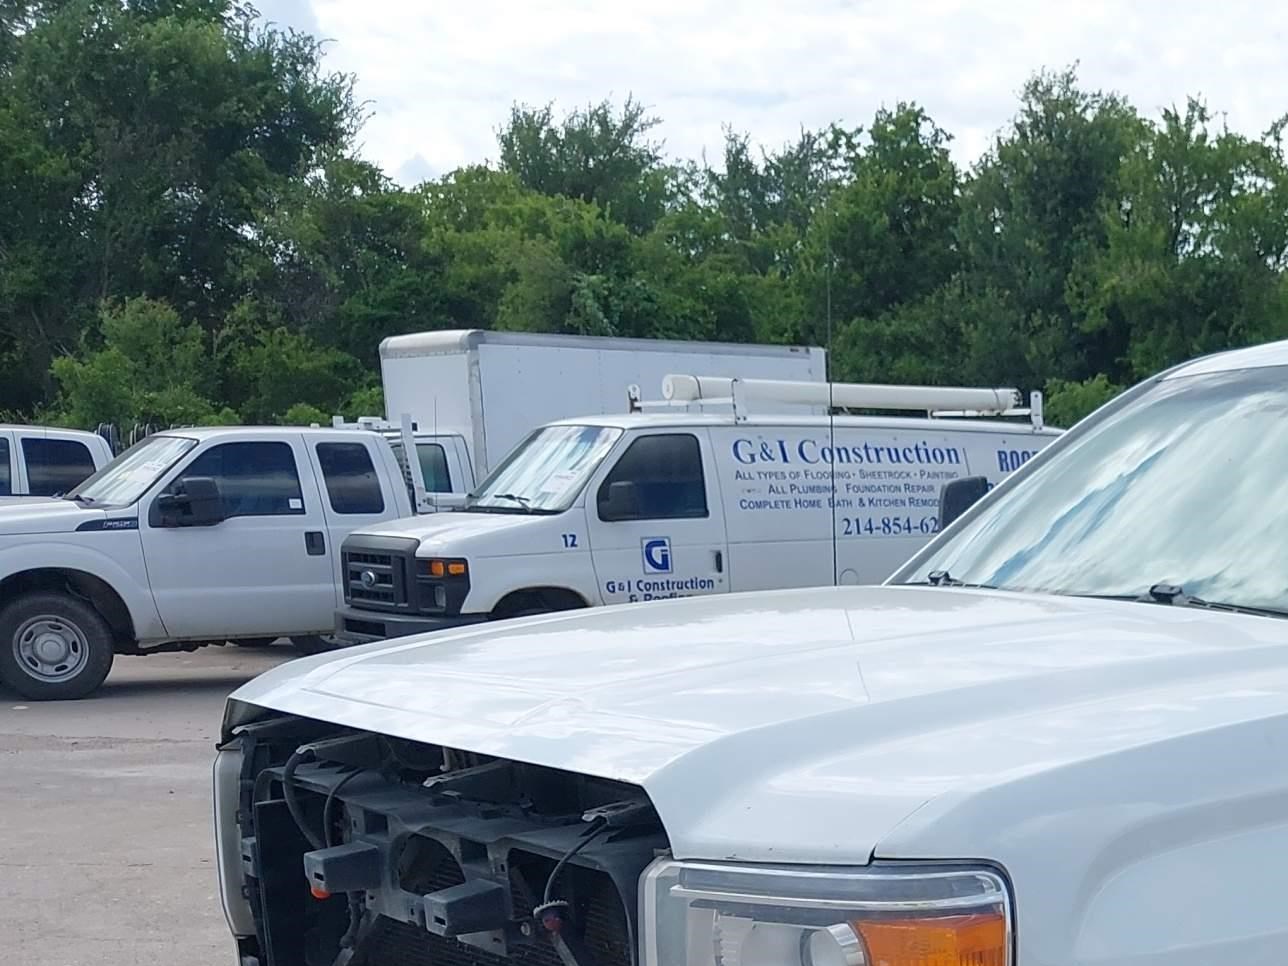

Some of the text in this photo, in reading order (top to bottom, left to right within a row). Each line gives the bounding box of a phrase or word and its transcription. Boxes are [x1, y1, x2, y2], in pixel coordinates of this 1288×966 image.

[797, 439, 960, 464] Construction
[997, 449, 1039, 472] ROO
[735, 470, 754, 480] ALL
[859, 469, 912, 480] SHEETROCK
[768, 484, 786, 494] ALL
[845, 483, 901, 494] FOUNDATION
[903, 483, 935, 494] REPAIR
[739, 499, 792, 510] COMPLETE
[795, 498, 822, 509] HOME
[868, 497, 906, 508] KITCHEN
[562, 534, 578, 548] 12
[636, 577, 715, 592] Construction
